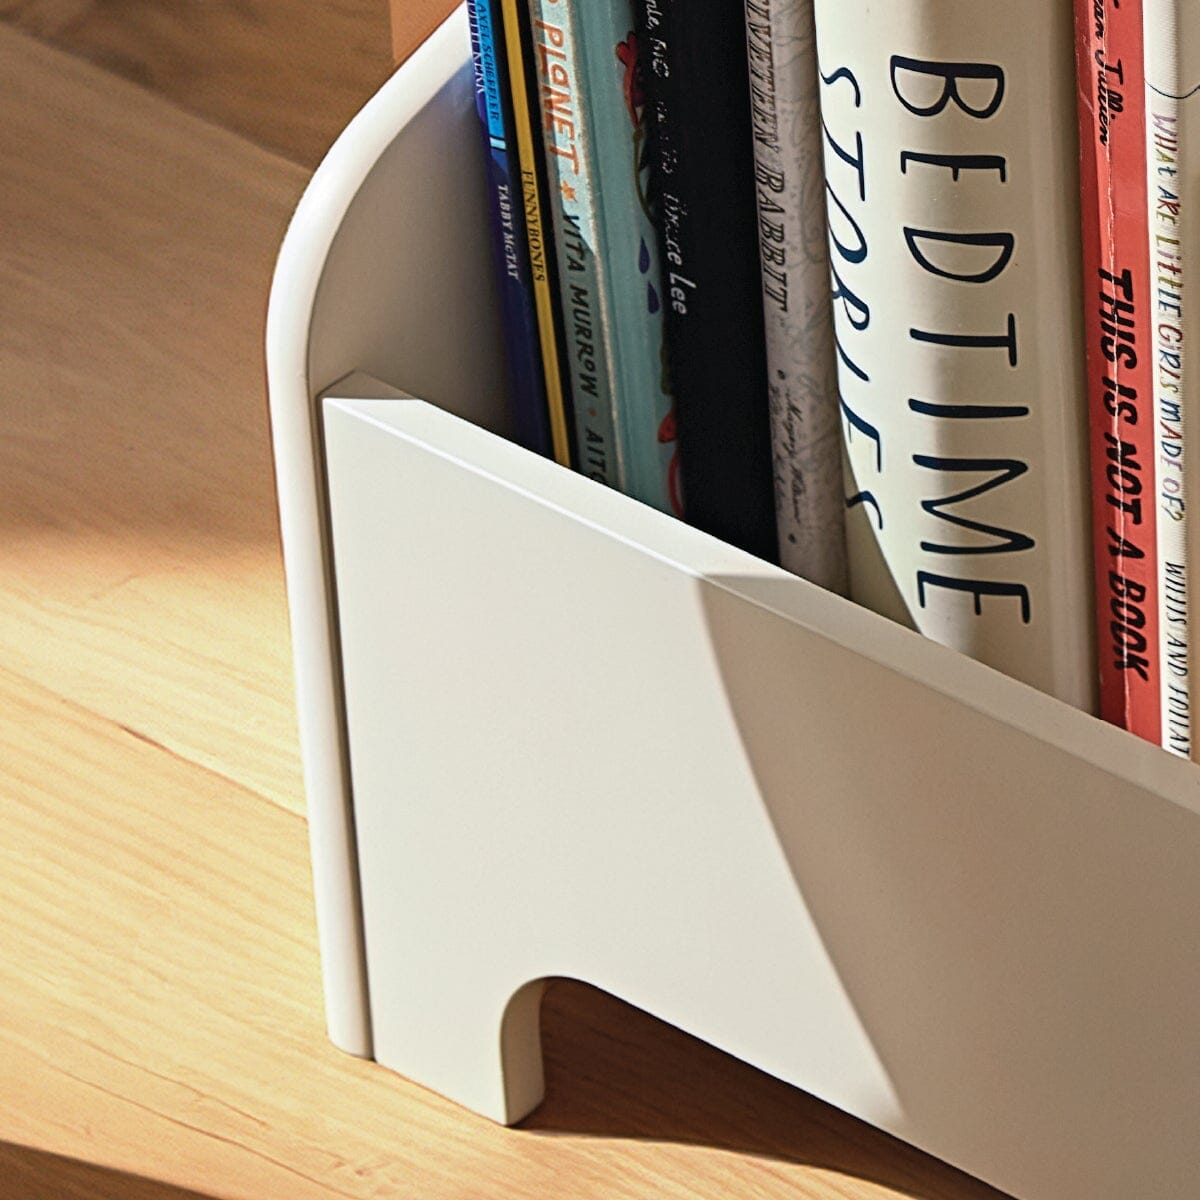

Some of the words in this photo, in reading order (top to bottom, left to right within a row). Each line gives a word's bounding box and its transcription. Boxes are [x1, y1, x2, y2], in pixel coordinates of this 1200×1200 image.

[477, 2, 491, 42] AXEL
[481, 43, 500, 121] SCHEFFLER
[1095, 49, 1124, 146] Jullien
[498, 183, 513, 230] TABBY
[522, 170, 545, 282] FUNNYBONES
[1155, 186, 1183, 226] ARE
[503, 231, 520, 281] McTAT
[562, 213, 586, 272] VITA
[755, 165, 789, 313] RABBIT
[669, 272, 697, 315] Lee
[818, 66, 884, 531] STORIES
[1098, 268, 1138, 369] THIS
[890, 55, 1036, 623] BEDTIME
[1102, 376, 1138, 425] IS
[1104, 432, 1143, 525] NOT
[1162, 477, 1186, 522] OF?
[1106, 525, 1145, 559] A
[1108, 570, 1149, 681] BOOK
[1167, 632, 1189, 677] AND
